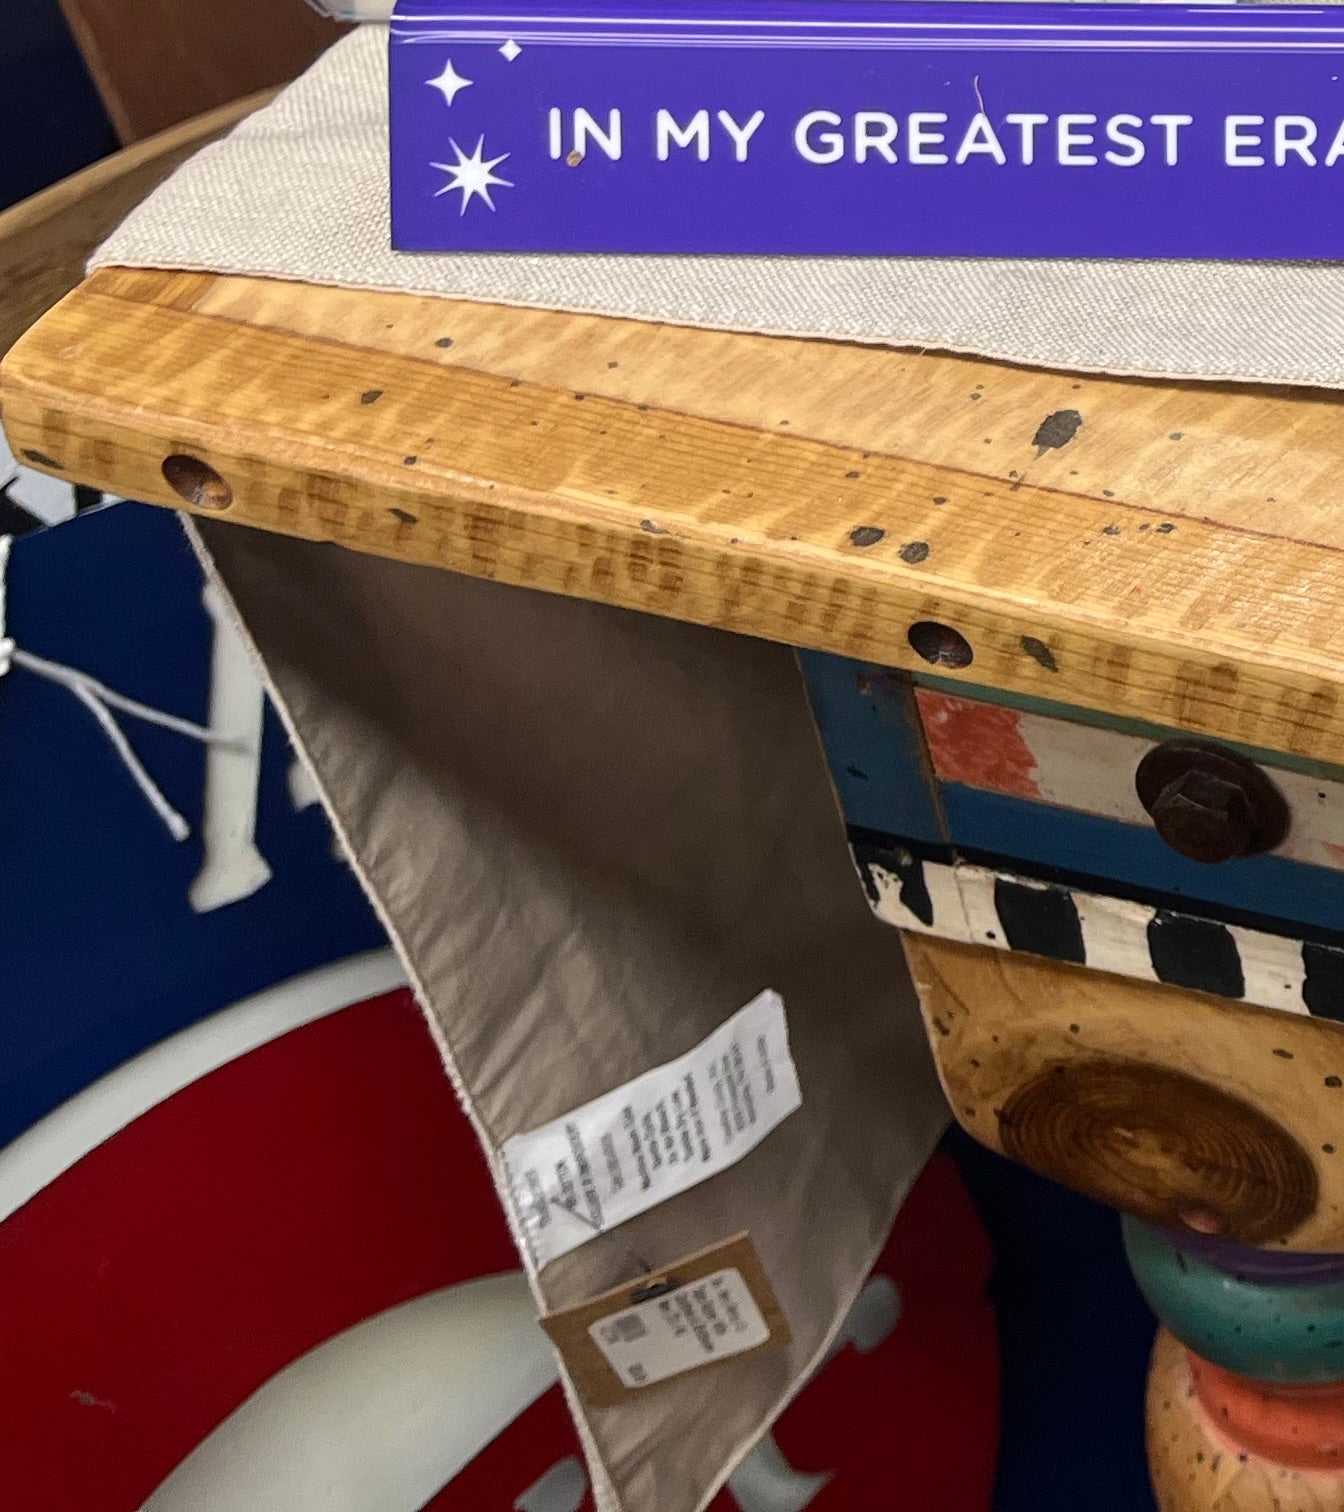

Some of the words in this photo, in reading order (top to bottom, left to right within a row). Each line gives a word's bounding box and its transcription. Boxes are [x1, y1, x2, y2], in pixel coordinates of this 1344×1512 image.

[546, 106, 623, 162] IN
[654, 108, 768, 164] MY
[792, 109, 1194, 167] GREATEST
